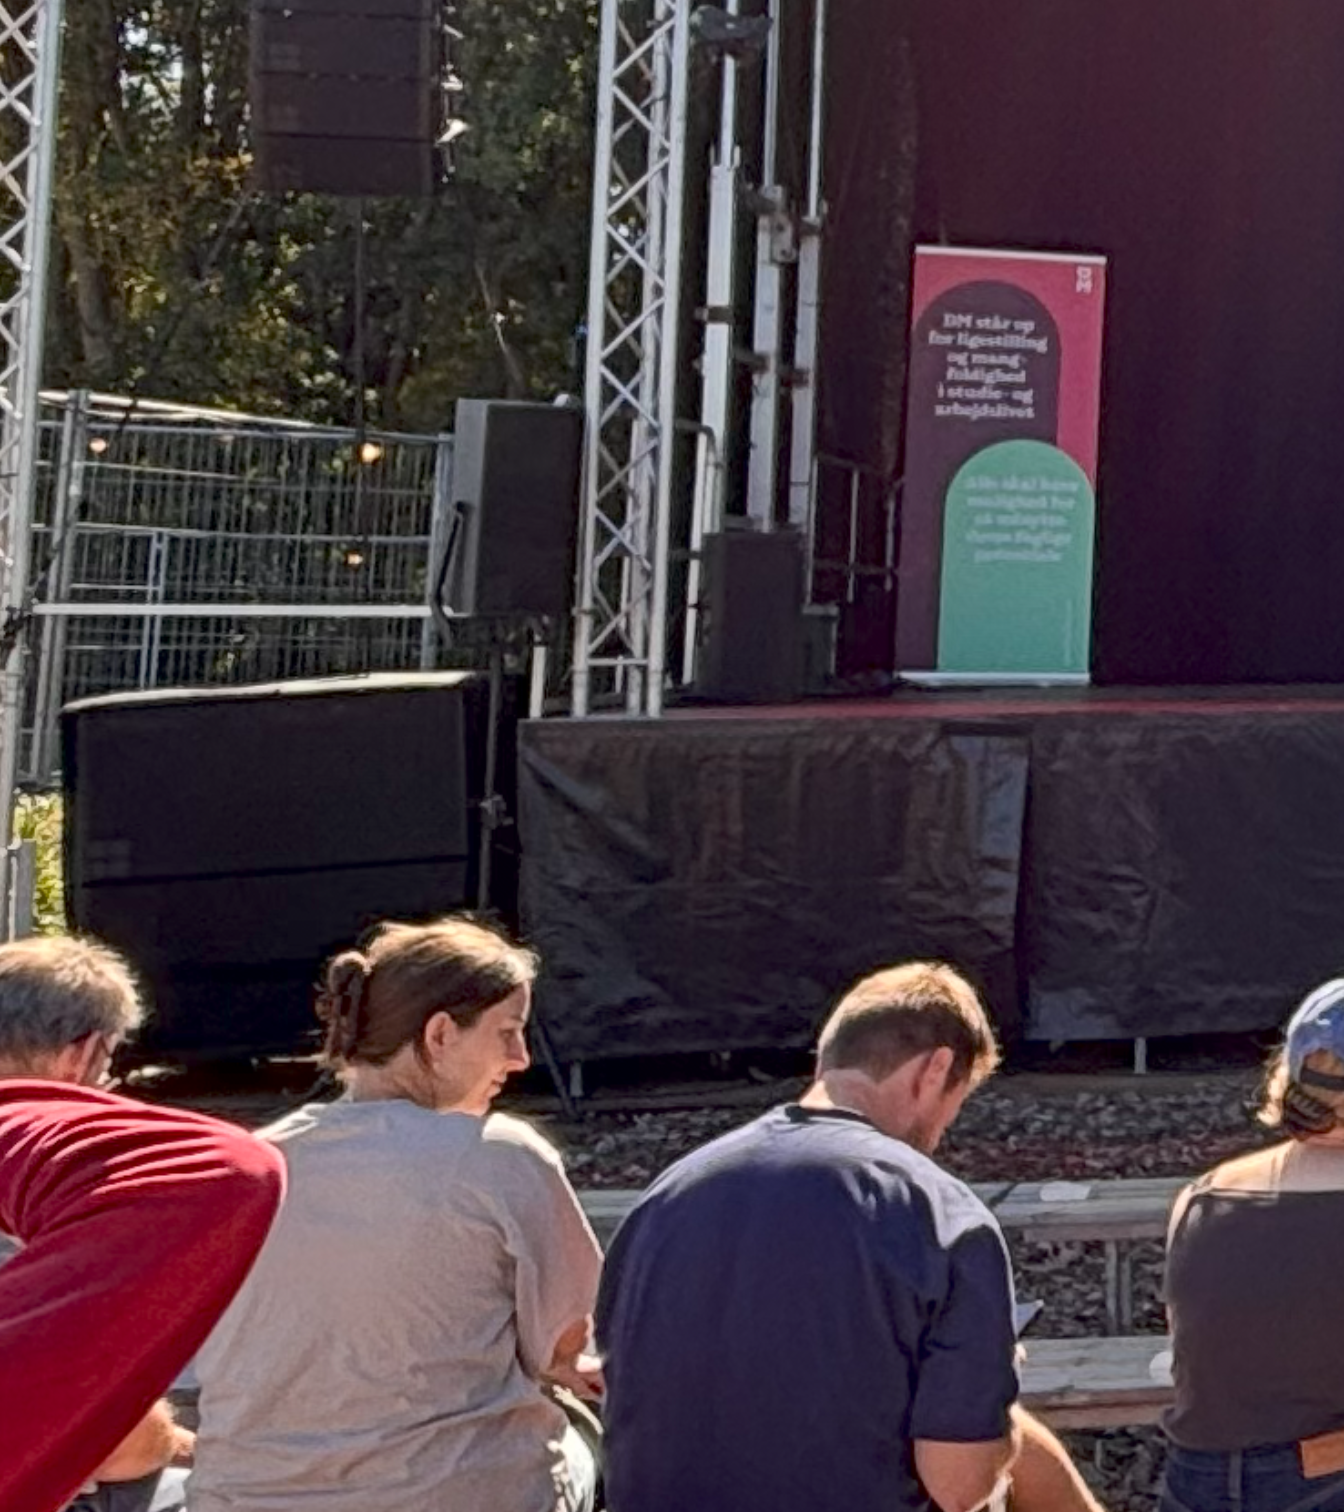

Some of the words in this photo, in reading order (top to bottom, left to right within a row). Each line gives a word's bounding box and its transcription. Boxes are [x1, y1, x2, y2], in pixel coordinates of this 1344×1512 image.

[943, 313, 973, 328] DM
[975, 314, 1011, 329] står
[928, 329, 955, 345] for
[956, 331, 1048, 354] ligestilling
[946, 352, 969, 367] og
[970, 353, 1029, 370] mang-
[946, 367, 1026, 385] foldighed
[1011, 388, 1034, 405] og
[934, 401, 1036, 422] arbejdslivet
